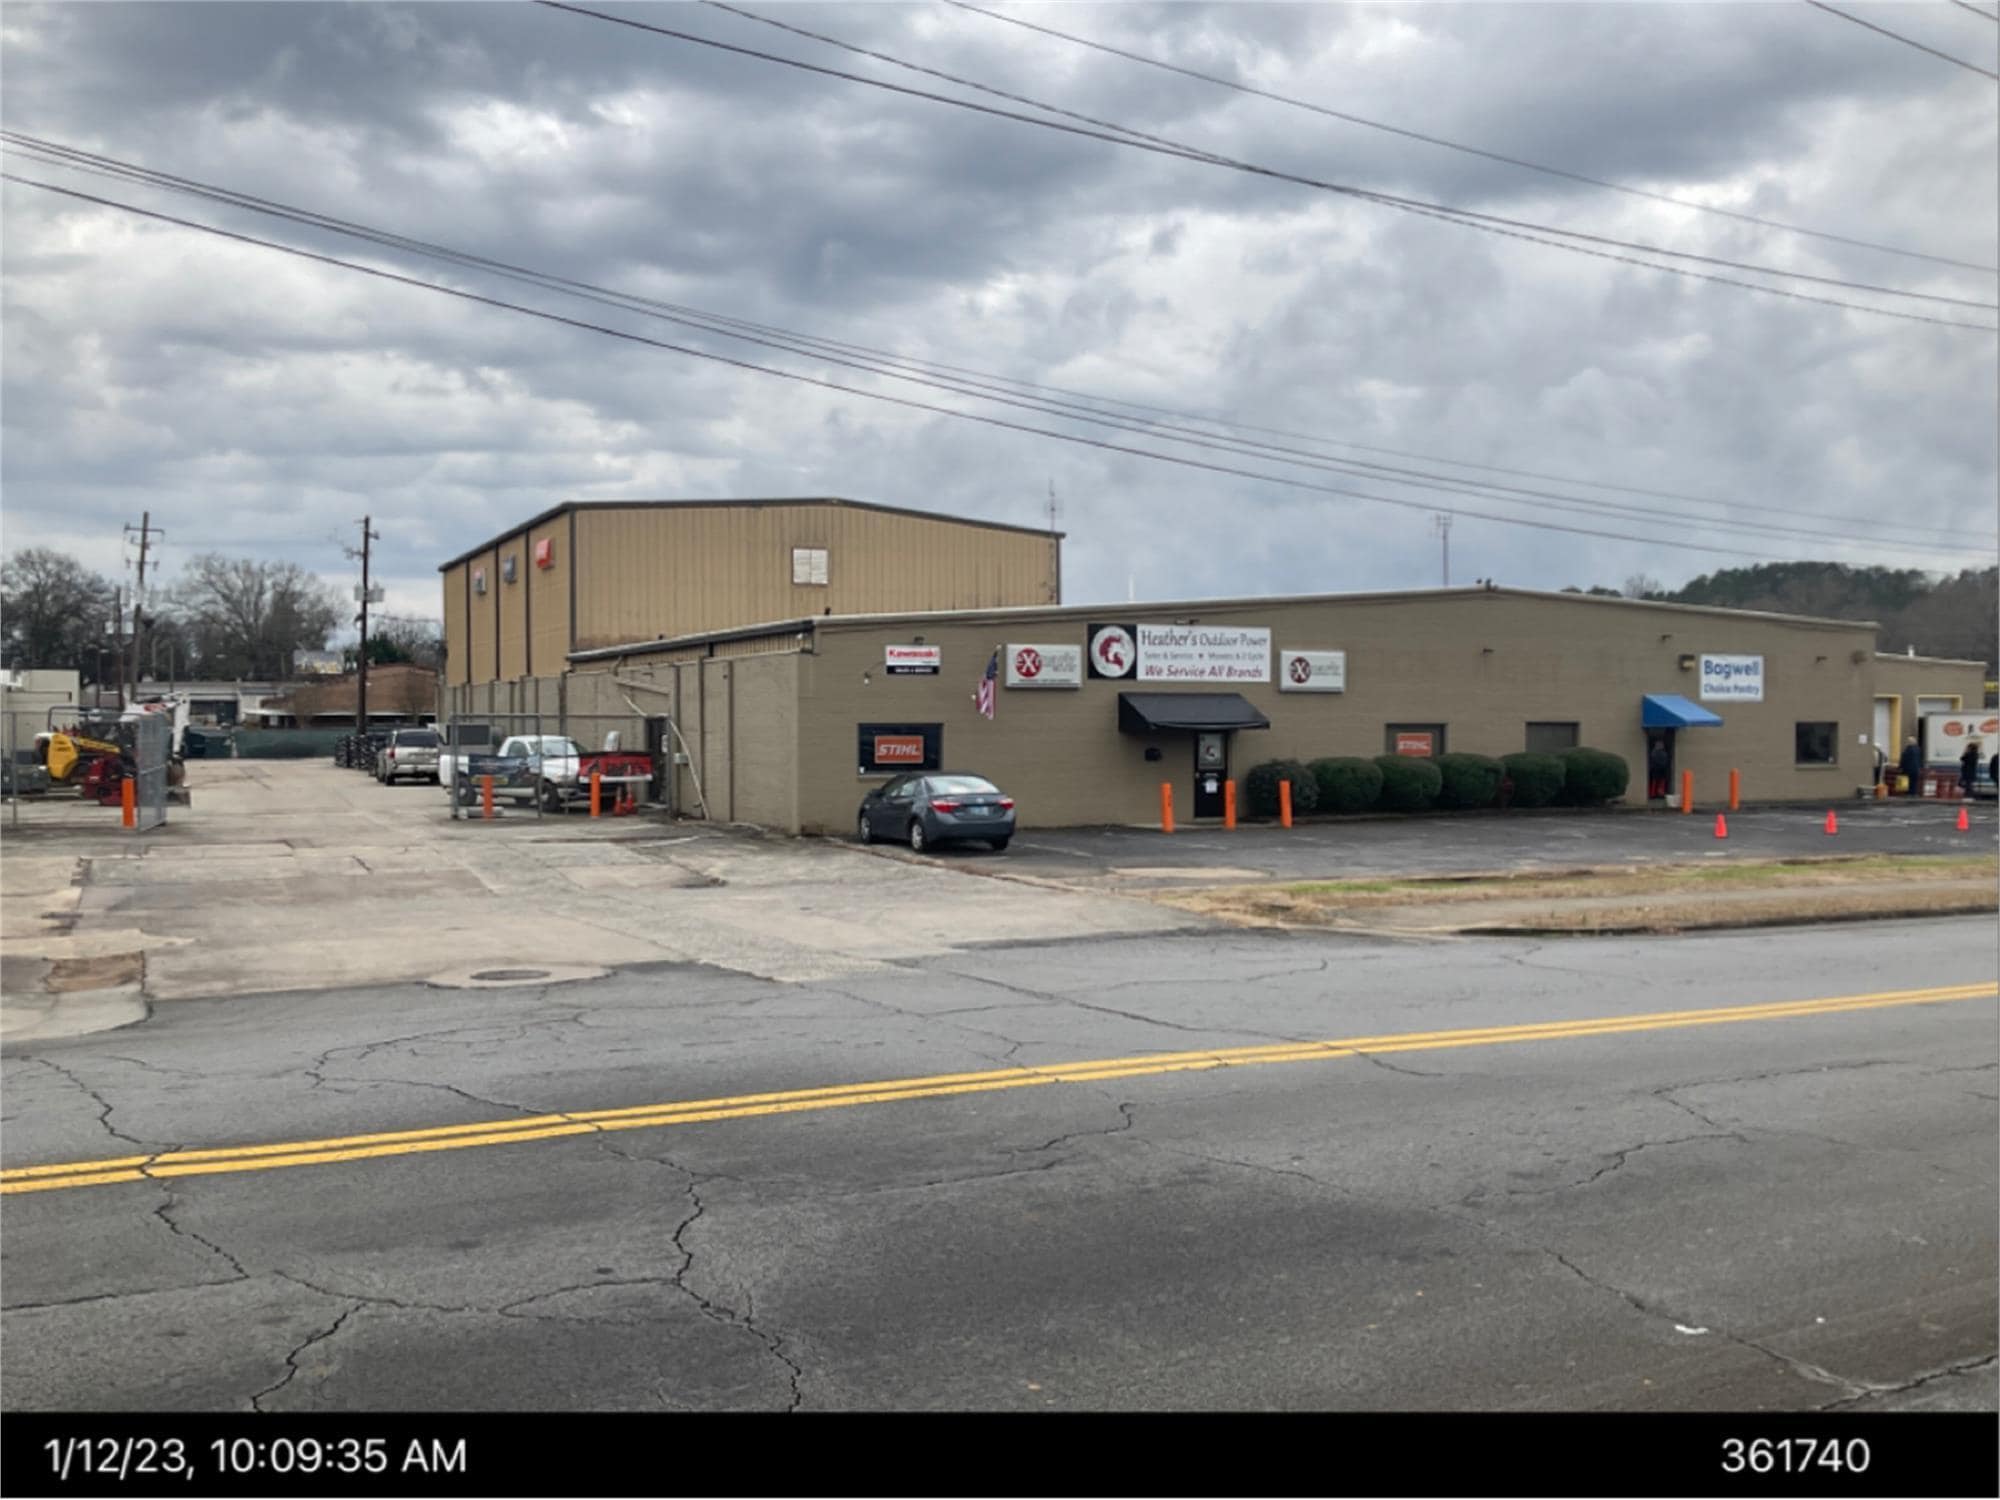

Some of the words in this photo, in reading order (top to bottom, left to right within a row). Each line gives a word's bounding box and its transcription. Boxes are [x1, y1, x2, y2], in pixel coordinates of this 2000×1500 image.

[1141, 628, 1198, 646] Heather's
[1199, 632, 1238, 646] Outdoor
[1239, 632, 1268, 646] Power
[1145, 664, 1163, 677] We
[1166, 664, 1206, 677] Service
[1208, 664, 1225, 677] All
[1226, 665, 1263, 678] Brands
[1704, 660, 1760, 680] Bagwell
[878, 744, 920, 756] STIHL
